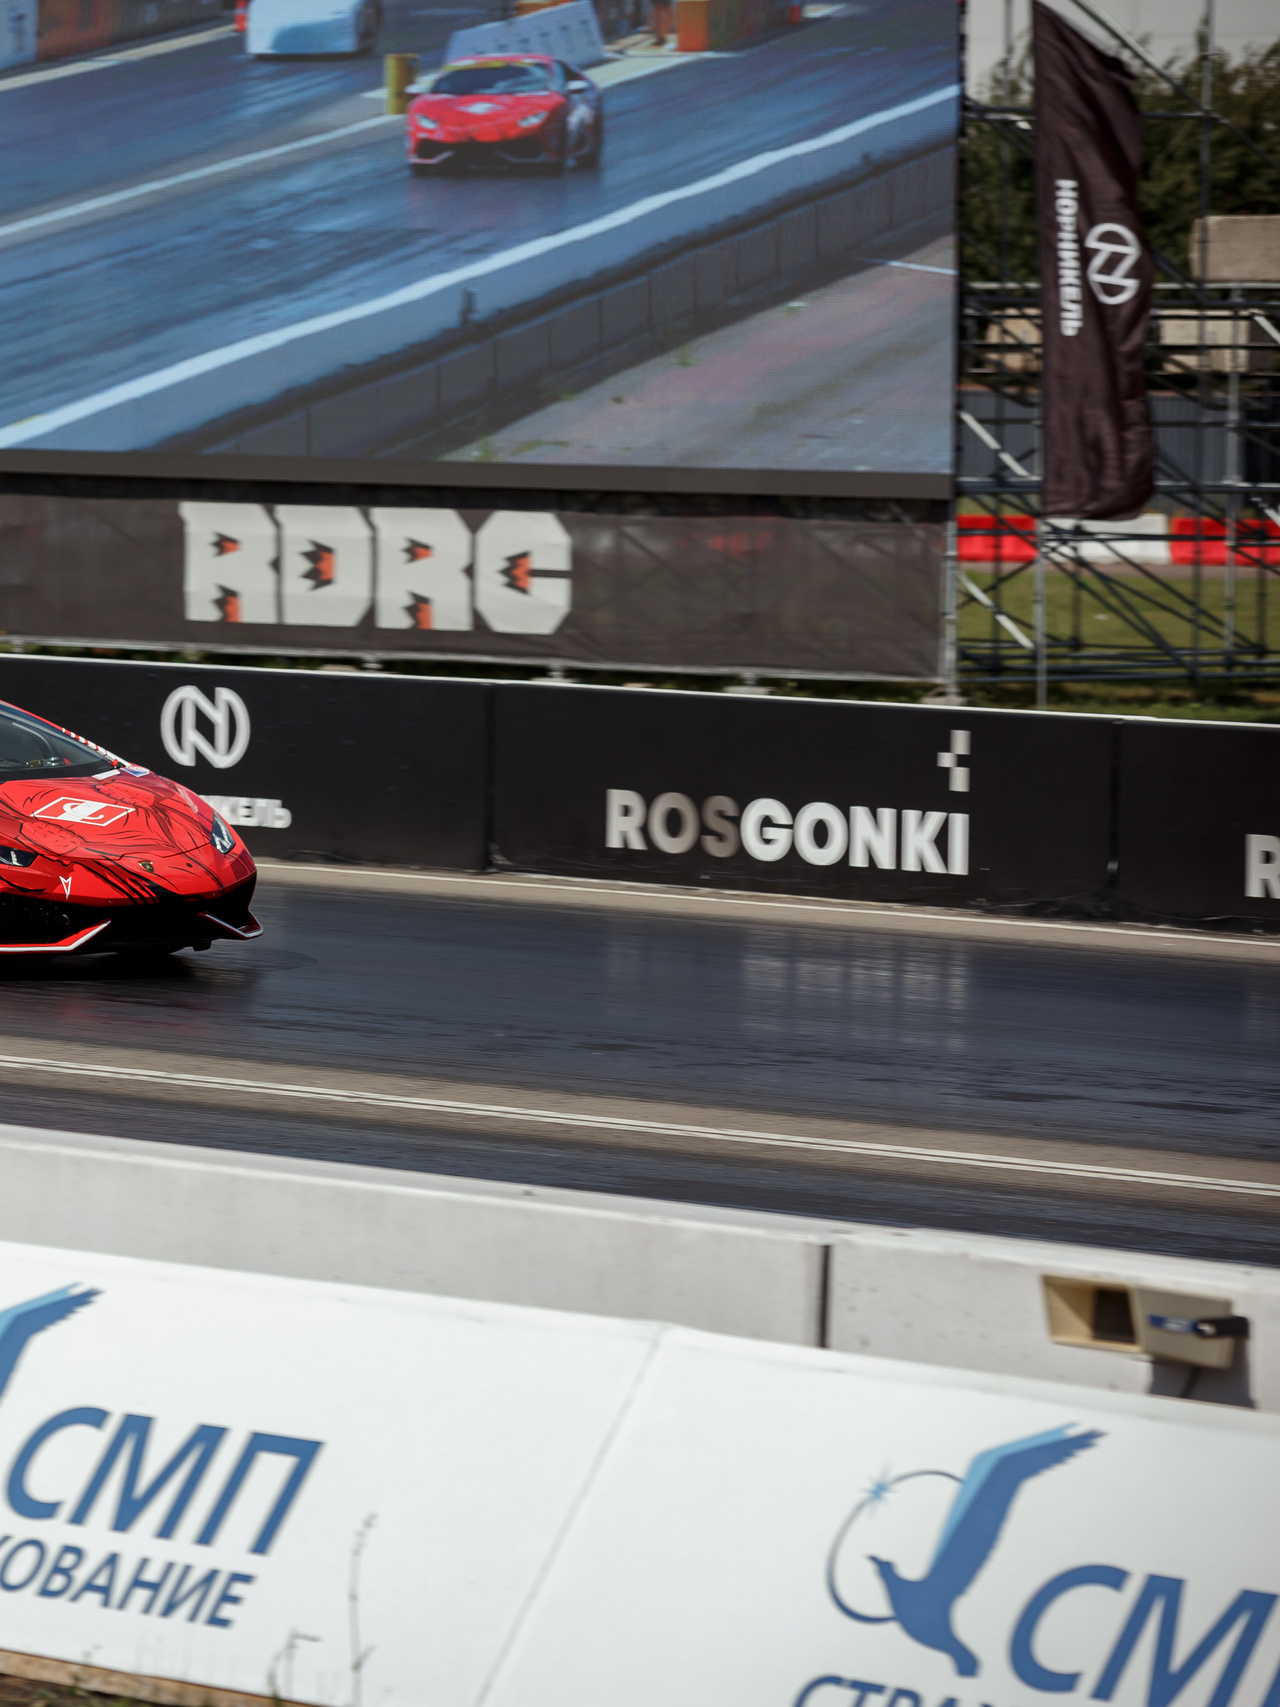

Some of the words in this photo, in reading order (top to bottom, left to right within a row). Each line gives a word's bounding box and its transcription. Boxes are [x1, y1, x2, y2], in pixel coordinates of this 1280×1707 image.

[179, 501, 572, 635] RDRC
[606, 789, 970, 876] ROSGONKI
[4, 1406, 326, 1556] СМП
[1008, 1563, 1280, 1707] СМ
